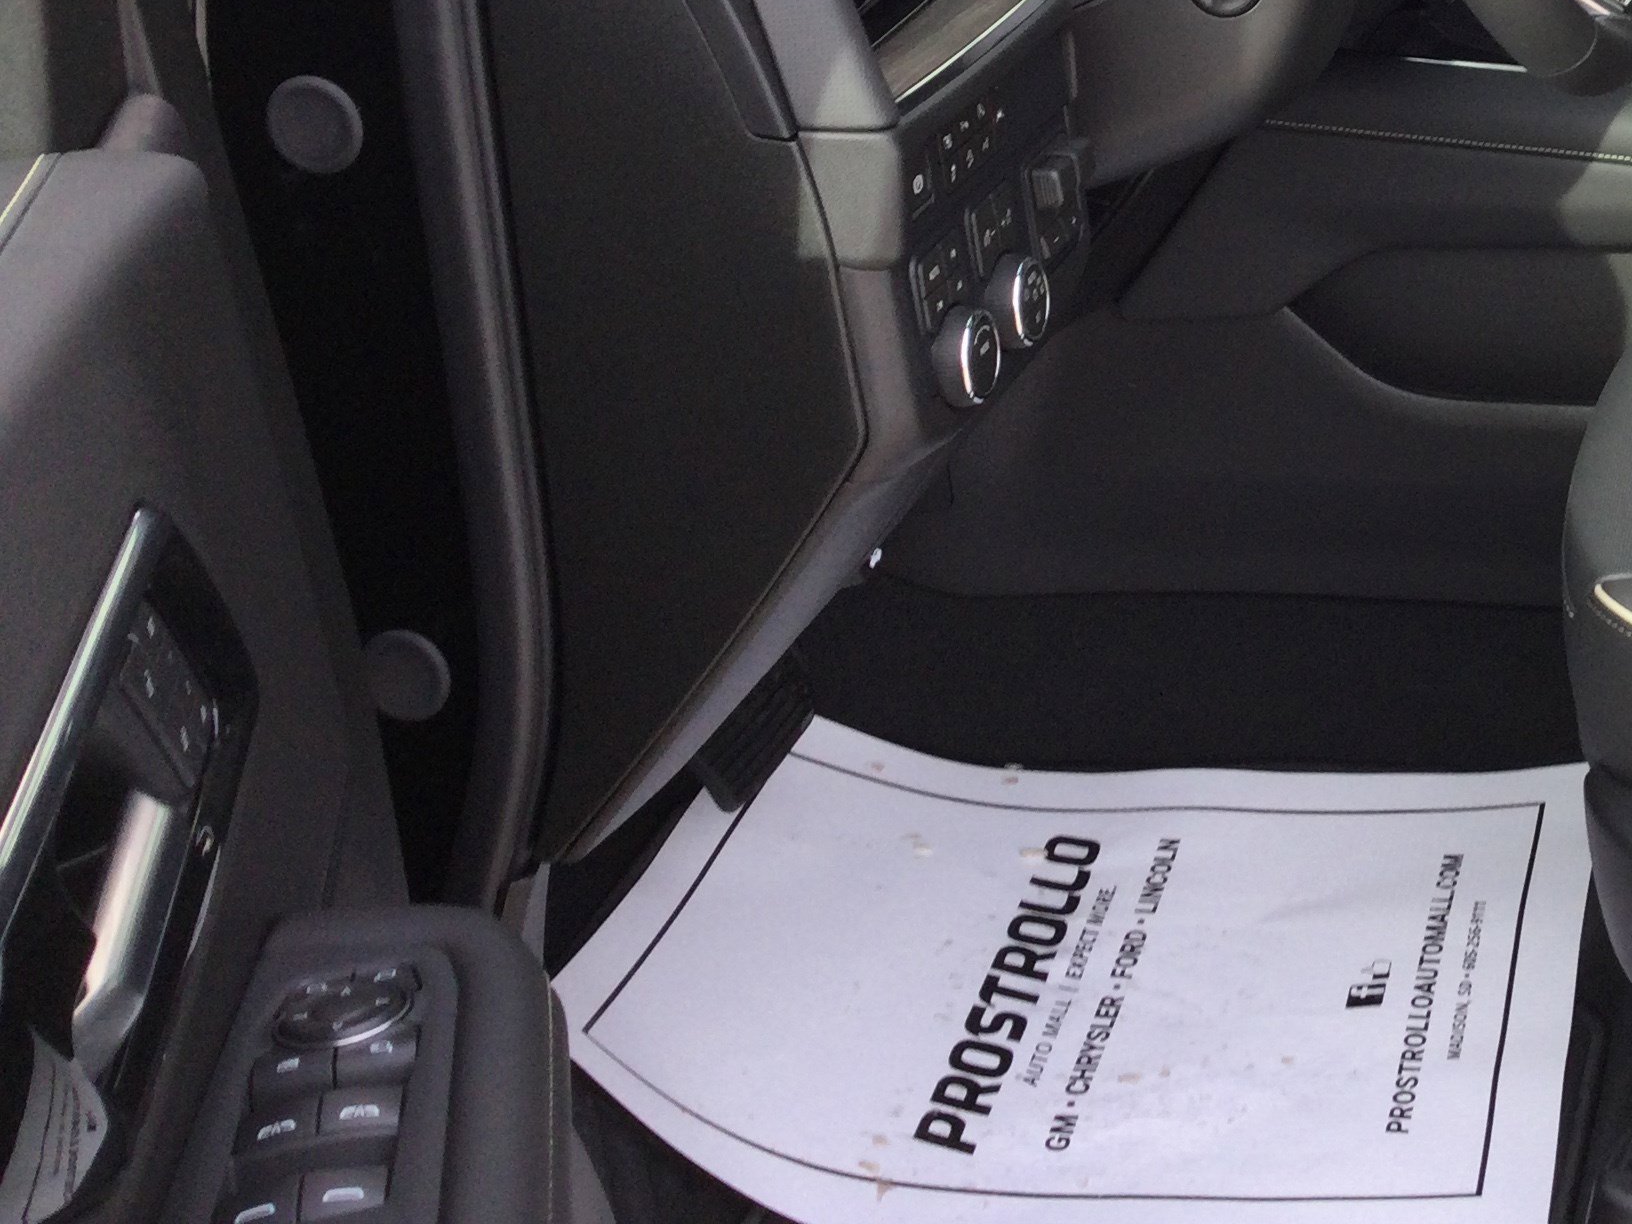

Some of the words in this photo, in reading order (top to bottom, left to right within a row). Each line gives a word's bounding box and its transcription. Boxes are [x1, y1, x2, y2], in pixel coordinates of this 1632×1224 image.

[912, 834, 1101, 1156] PROSTROLLO
[1023, 1041, 1053, 1088] AUTO
[1042, 998, 1072, 1039] MALL
[1045, 1114, 1079, 1152] GM
[1065, 995, 1125, 1096] CHRYSLER
[1111, 929, 1147, 980] FORD
[1135, 838, 1181, 915] LINCOLN
[1385, 853, 1464, 1135] PROSTROLLOAUTOMALL.COM
